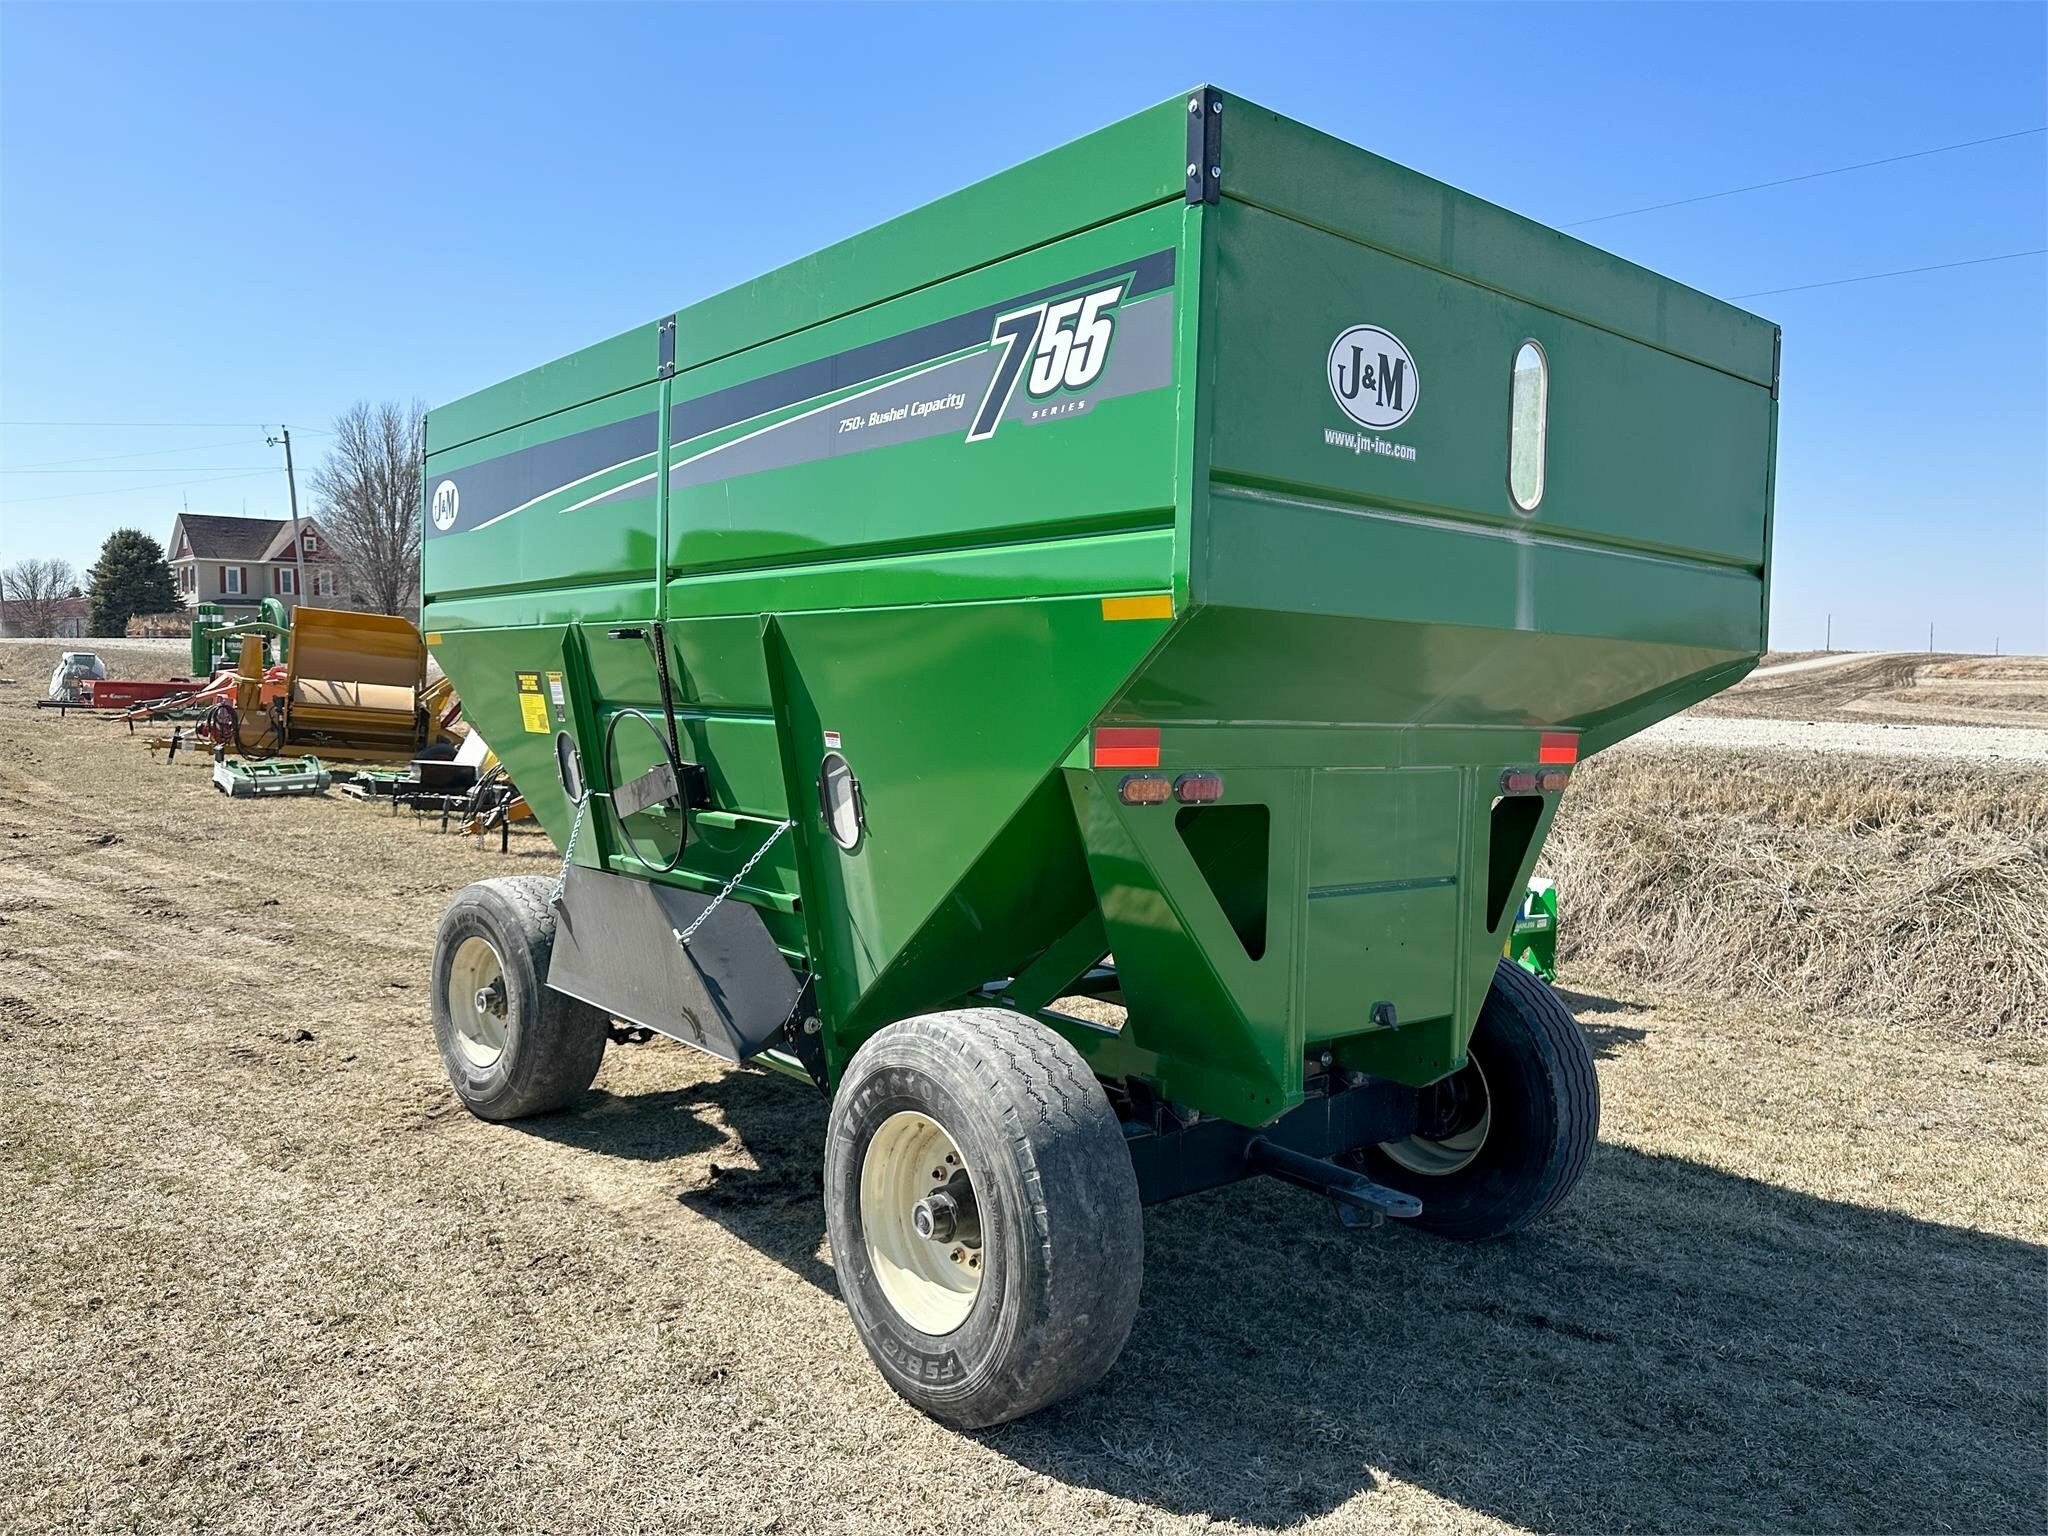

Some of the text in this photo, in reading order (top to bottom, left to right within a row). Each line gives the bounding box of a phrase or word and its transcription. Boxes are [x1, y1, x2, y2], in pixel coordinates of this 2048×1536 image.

[965, 284, 1124, 443] 755
[1338, 345, 1406, 411] J&M
[838, 392, 966, 433] 750+ Bushel Capacity
[1031, 400, 1086, 419] SERIES
[1324, 427, 1416, 461] www.jm-inc.com
[434, 488, 455, 522] J&M
